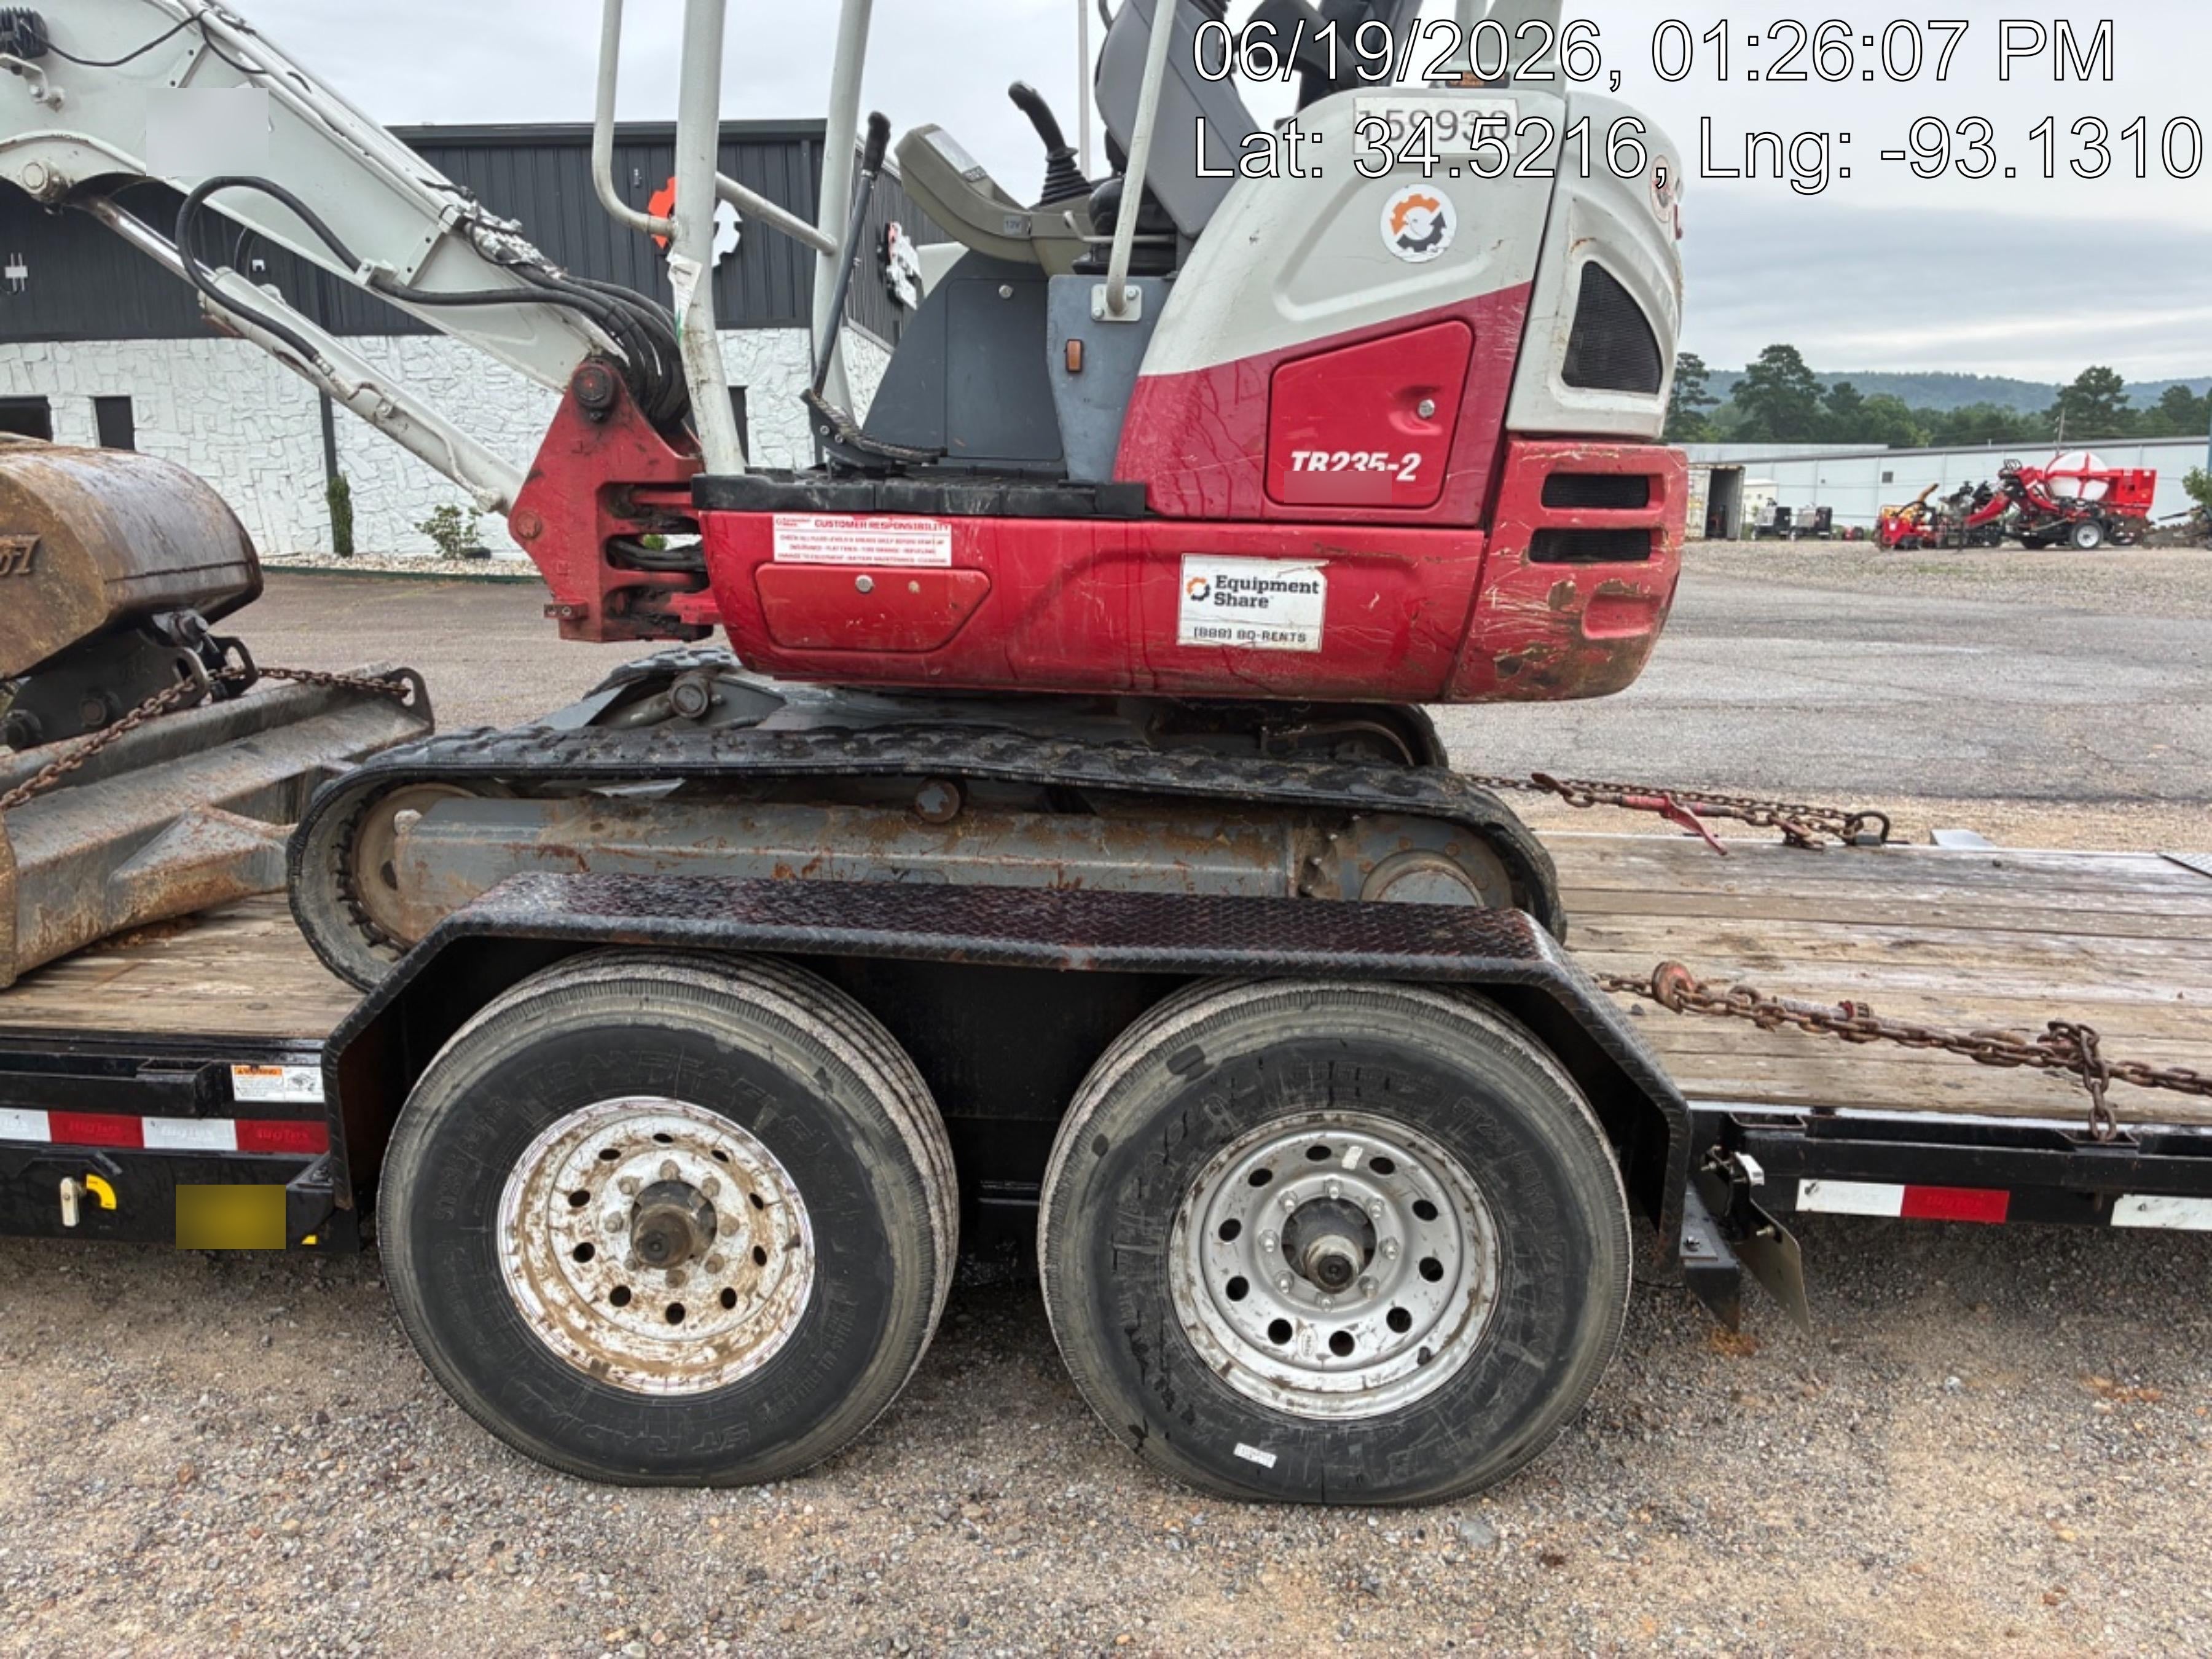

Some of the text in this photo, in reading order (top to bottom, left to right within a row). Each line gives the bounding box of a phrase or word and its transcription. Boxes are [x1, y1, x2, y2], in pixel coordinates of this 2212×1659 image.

[1291, 451, 1422, 482] TR235-2
[1215, 575, 1320, 594] Equipment
[1214, 592, 1269, 608] Share
